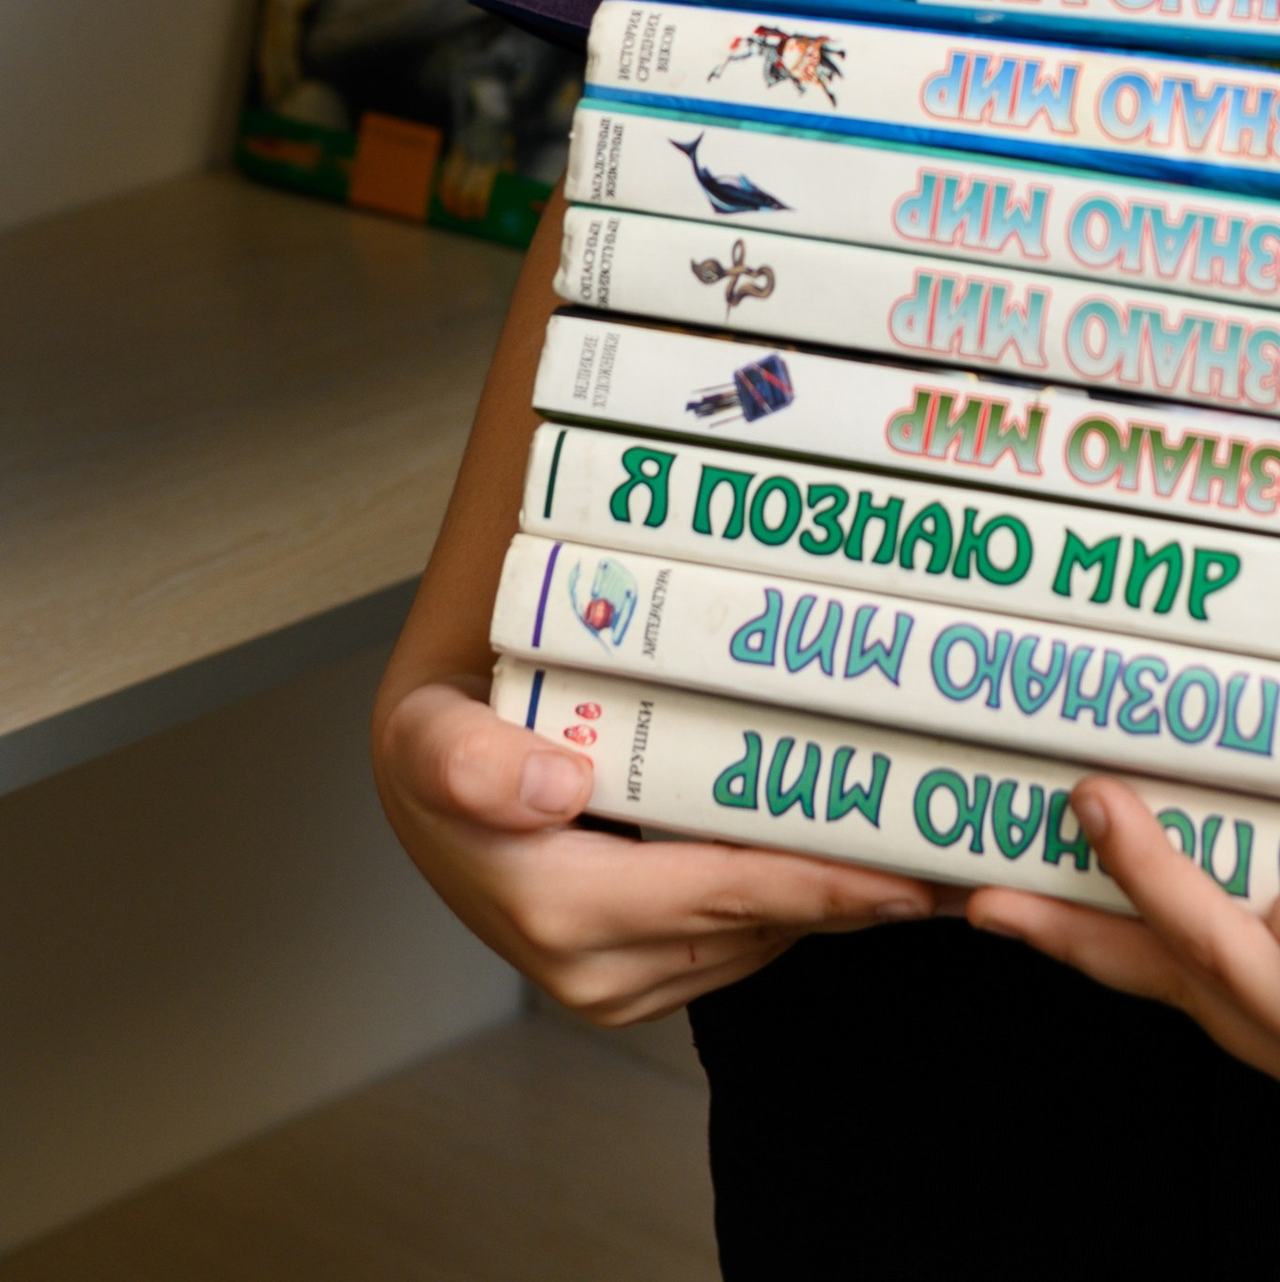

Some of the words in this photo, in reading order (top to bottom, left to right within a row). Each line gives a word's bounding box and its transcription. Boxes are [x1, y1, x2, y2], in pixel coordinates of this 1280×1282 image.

[618, 9, 644, 81] ИСТОРИЯ
[636, 12, 662, 83] СРЕДНИХ
[658, 25, 677, 72] ВЕКОВ
[920, 48, 1083, 135] МИР
[606, 122, 623, 197] ЖИВОТНЫЕ
[580, 221, 601, 301] ОПАСНЫЕ
[892, 167, 1053, 262] МИР
[599, 217, 621, 310] ЖИВОТНЫЕ
[887, 267, 1052, 370] МИР
[574, 335, 598, 400] ВЕЛИКИЕ
[885, 383, 1052, 478] МИР
[609, 445, 678, 528] Я
[692, 463, 1033, 586] ПОЗНАЮ
[1052, 528, 1241, 622] МИР
[643, 568, 671, 659] ЛИТЕРАТУРА
[729, 587, 915, 686] МИР
[930, 622, 1280, 757] ПОЗНАЮ
[627, 699, 654, 802] ИГРУШКИ
[713, 730, 891, 829] МИР
